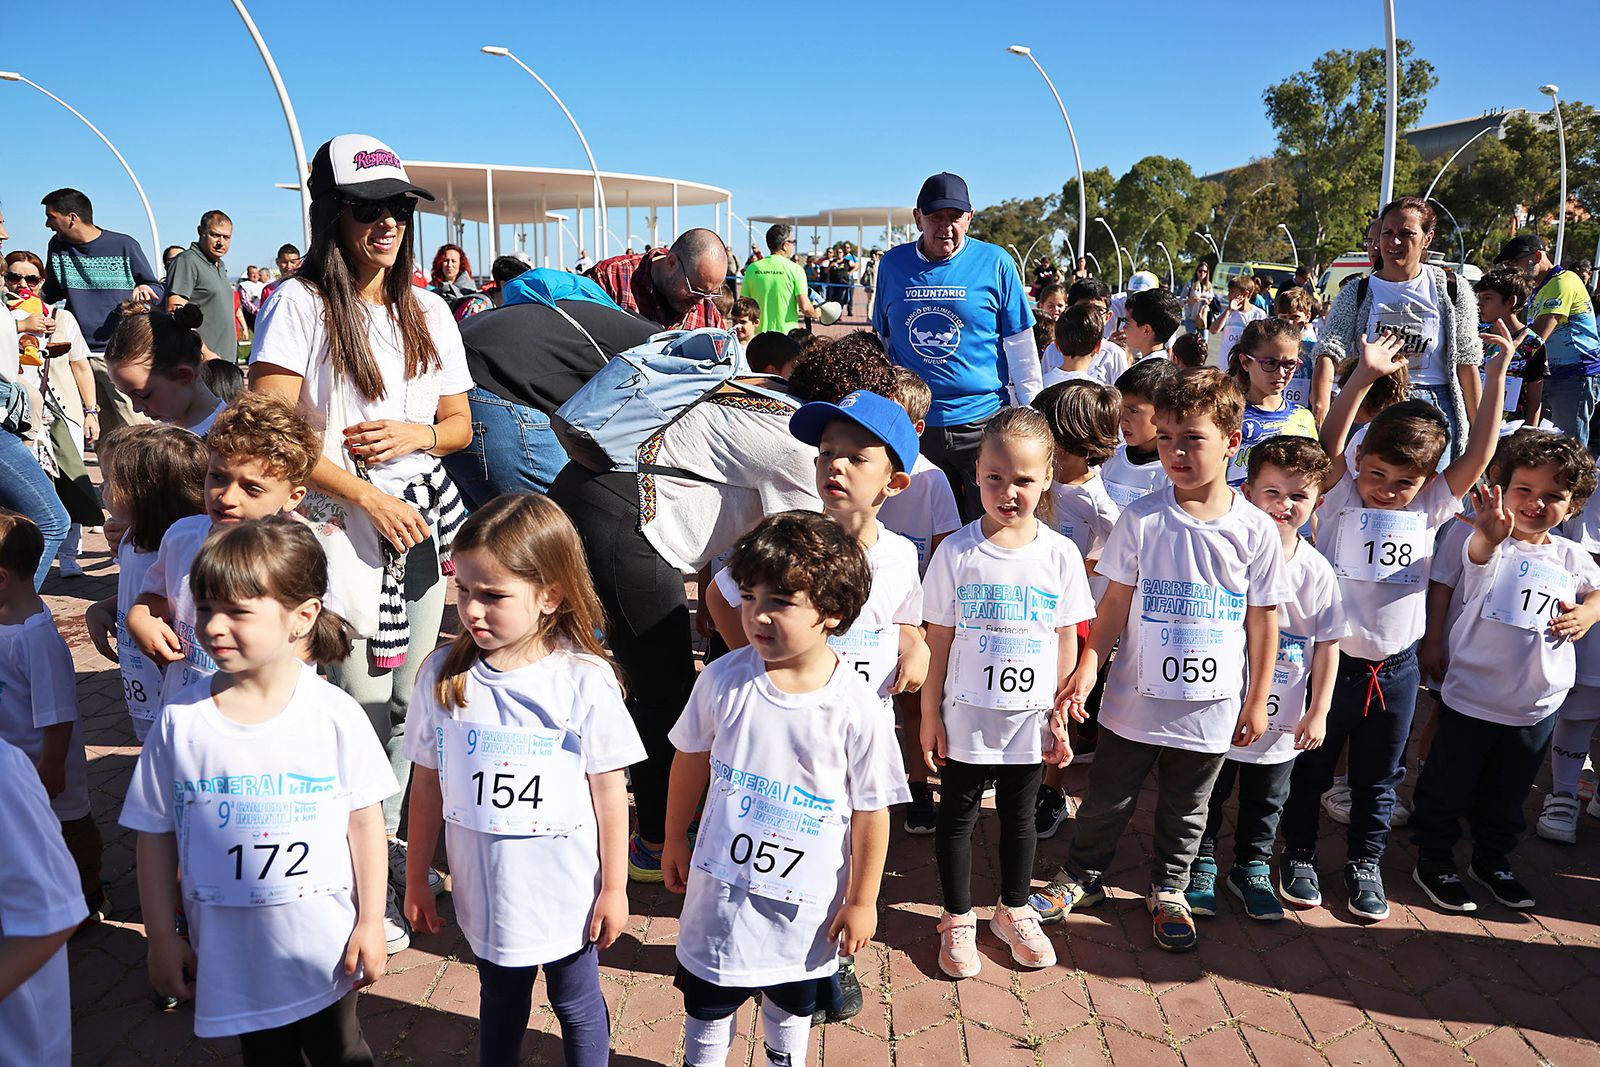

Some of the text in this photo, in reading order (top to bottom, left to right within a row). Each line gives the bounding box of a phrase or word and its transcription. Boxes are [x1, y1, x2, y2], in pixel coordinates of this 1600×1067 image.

[905, 289, 966, 298] VOLUNTARIO
[904, 308, 922, 327] BANCO
[933, 306, 964, 329] ALIMENTOS
[1400, 338, 1432, 353] elf
[1364, 540, 1412, 567] 138
[1142, 578, 1212, 600] CARRERA
[1142, 595, 1212, 618] INFANTIL
[1220, 594, 1244, 608] kilos
[1521, 589, 1560, 619] 170
[1031, 611, 1038, 621] x
[1218, 610, 1224, 619] x
[1280, 638, 1306, 650] kilos
[1278, 652, 1285, 660] x
[1162, 656, 1217, 683] 059
[983, 665, 1035, 692] 169
[533, 740, 553, 748] kilos
[472, 771, 543, 809] 154
[802, 818, 820, 829] kilos
[807, 826, 819, 836] km
[227, 841, 310, 881] 172
[730, 833, 805, 878] 057
[1290, 860, 1313, 868] Polo
[1353, 872, 1377, 881] Polo
